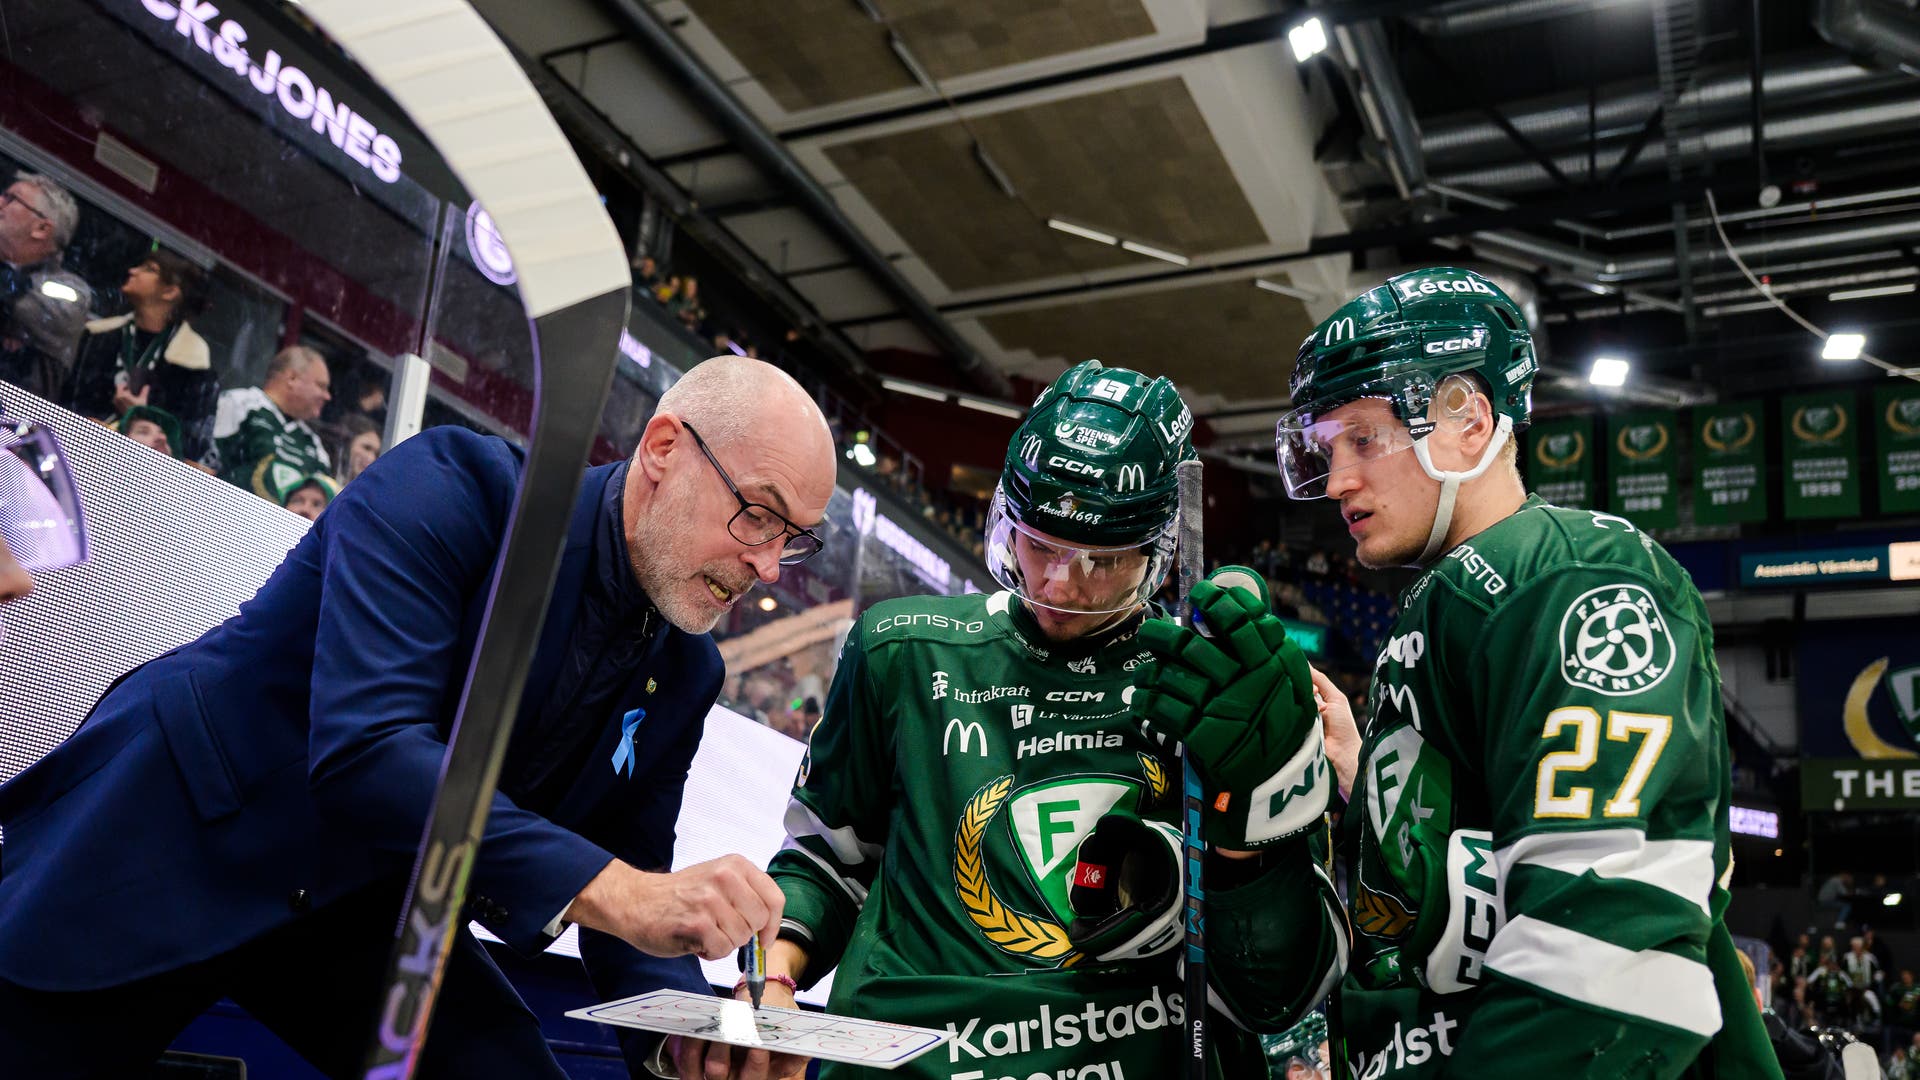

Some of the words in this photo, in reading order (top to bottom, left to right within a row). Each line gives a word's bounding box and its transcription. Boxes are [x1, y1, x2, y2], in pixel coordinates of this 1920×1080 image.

[1426, 332, 1482, 354] CCM
[1075, 435, 1098, 448] SPEL
[1410, 425, 1434, 434] CCM
[1049, 455, 1105, 478] CCM
[1069, 511, 1102, 525] 1698
[1576, 588, 1663, 632] FLÄKT
[1565, 654, 1663, 690] TEKNIK
[954, 685, 1031, 704] Infrakraft
[1045, 691, 1106, 702] CCM
[1017, 731, 1123, 760] Helmia
[1533, 706, 1673, 819] 27
[1833, 769, 1920, 798] THE
[1456, 836, 1498, 985] CCM
[364, 838, 477, 1080] CKS
[946, 985, 1185, 1064] Karlstads
[1193, 1019, 1203, 1059] OLLMAT
